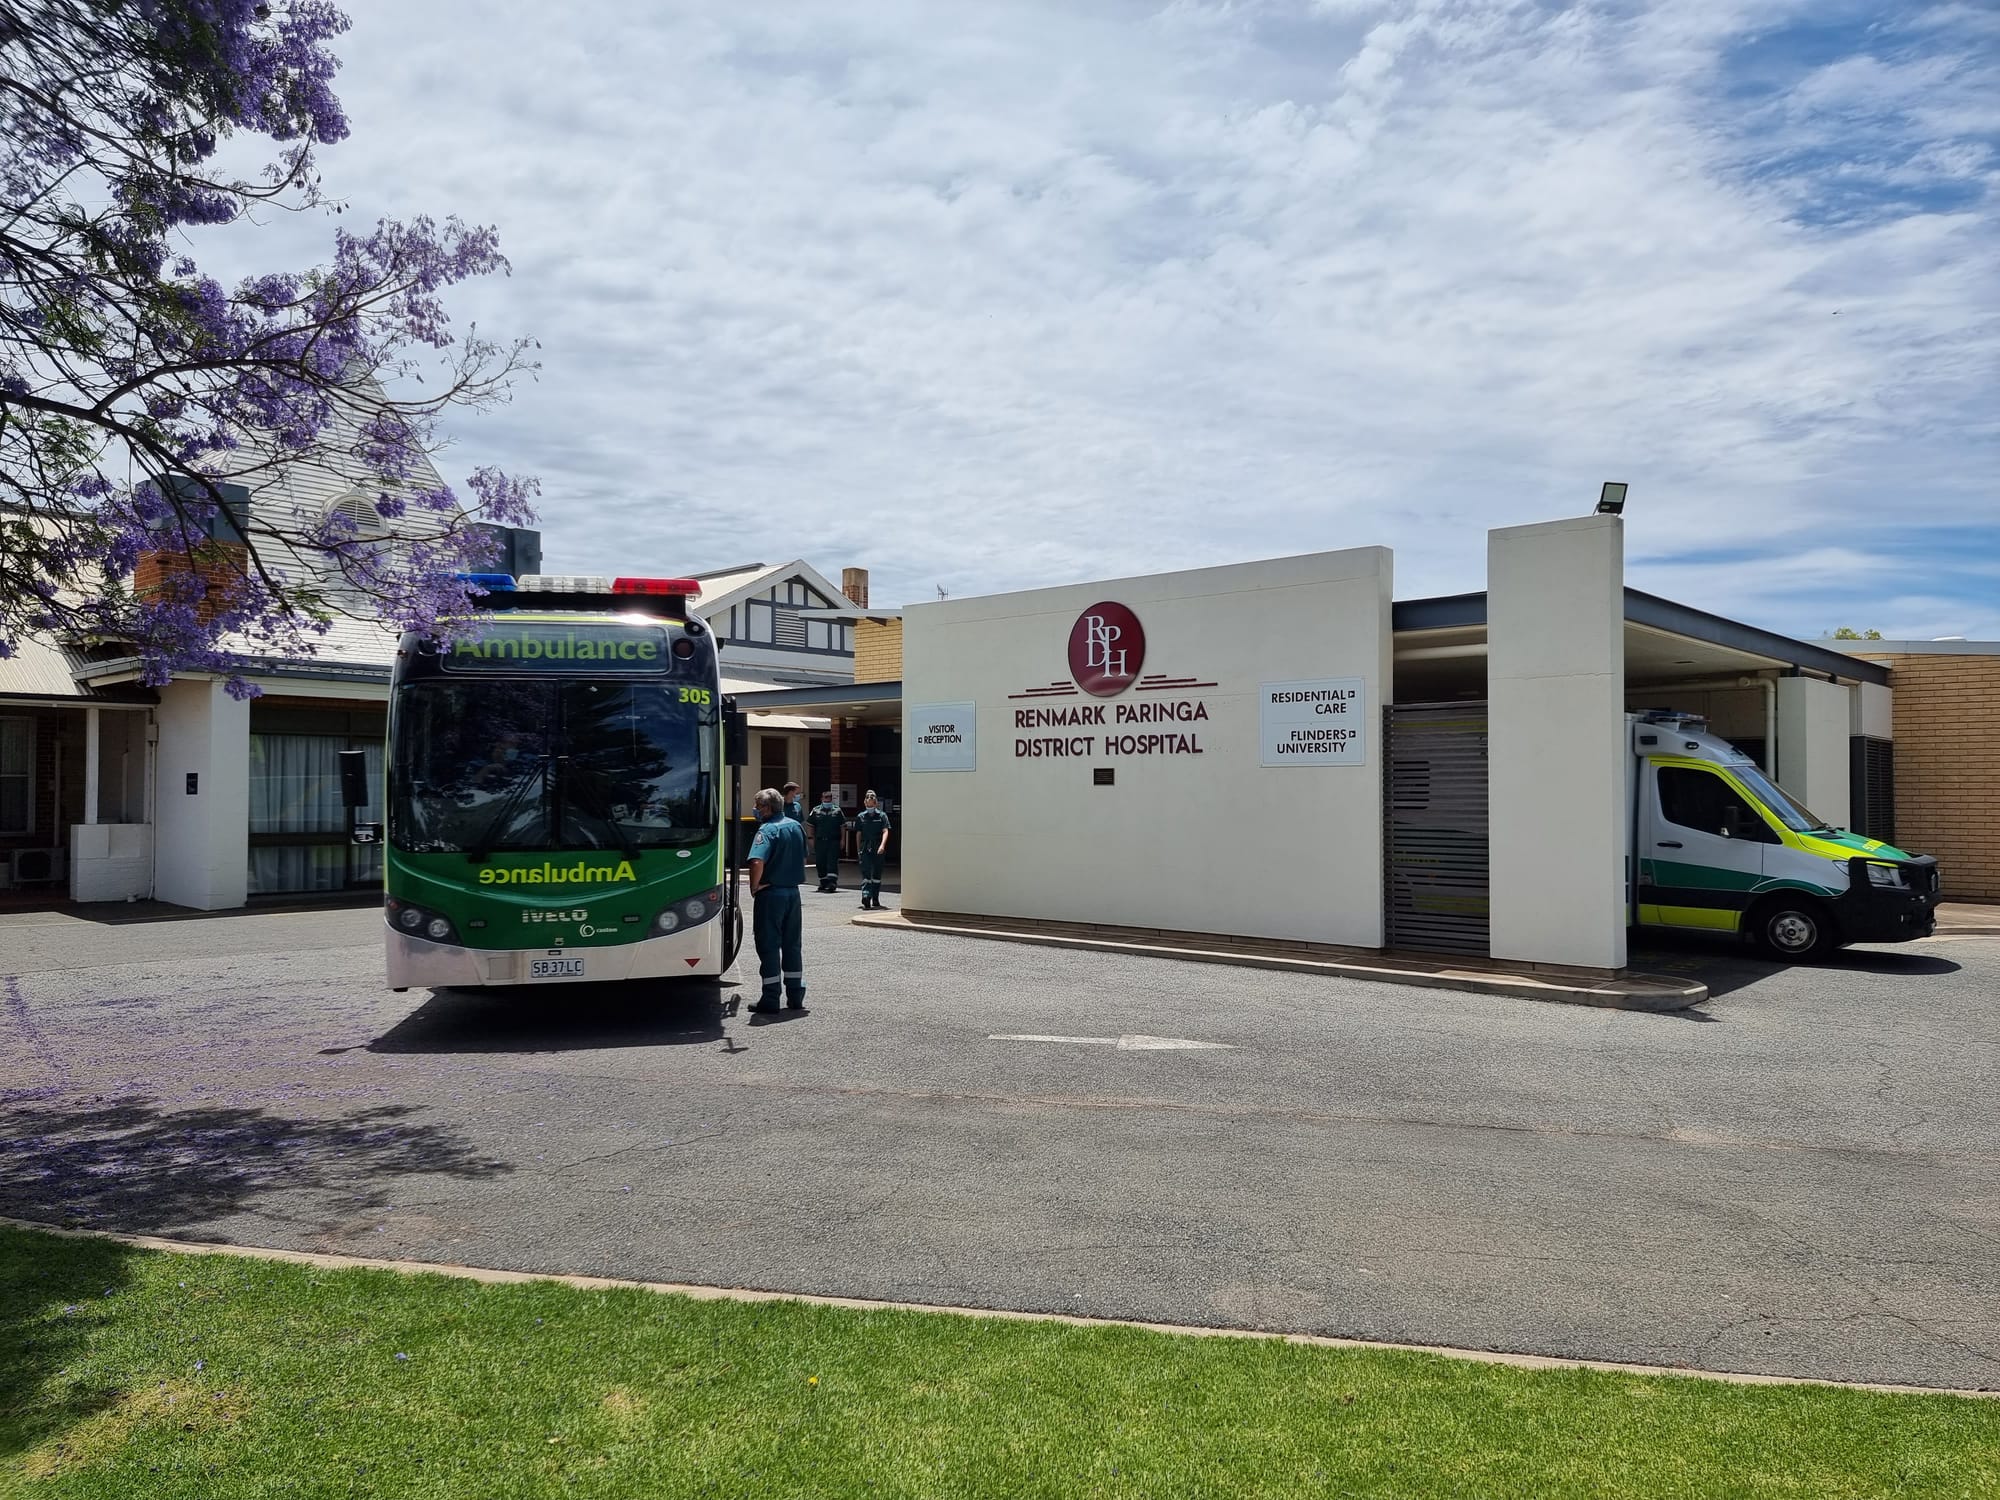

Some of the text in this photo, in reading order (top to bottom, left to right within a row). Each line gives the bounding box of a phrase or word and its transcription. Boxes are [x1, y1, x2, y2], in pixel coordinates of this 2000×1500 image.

[456, 632, 656, 660] Ambulance
[680, 688, 711, 705] 305
[1271, 690, 1346, 703] RESIDENTIAL
[1015, 701, 1209, 728] RENMARK PARINGA
[1315, 703, 1347, 715] CARE
[929, 725, 955, 734] VISITOR
[1291, 729, 1347, 741] FLINDERS
[924, 734, 962, 744] RECEPTION
[1015, 734, 1203, 758] DISTRICT HOSPITAL
[1277, 742, 1346, 753] UNIVERSITY
[522, 909, 588, 923] IVECO
